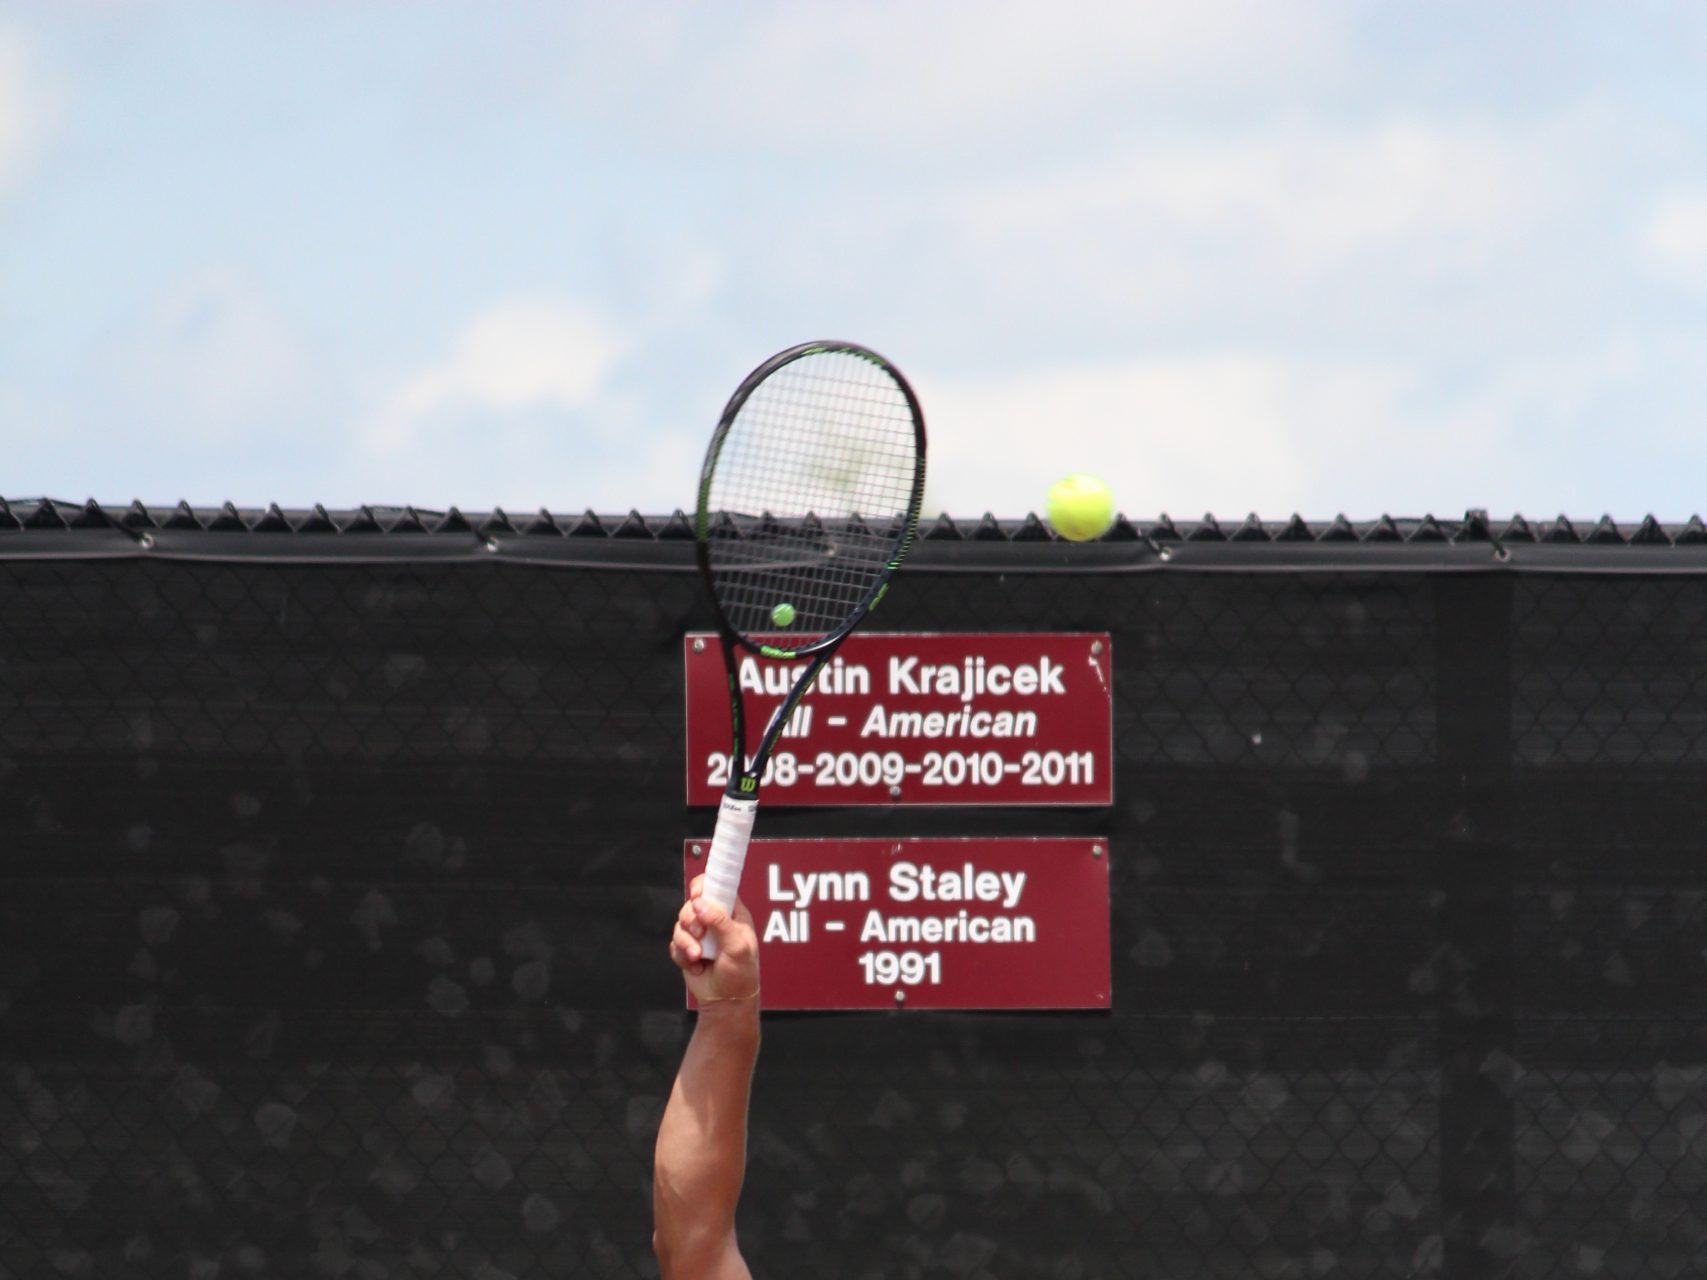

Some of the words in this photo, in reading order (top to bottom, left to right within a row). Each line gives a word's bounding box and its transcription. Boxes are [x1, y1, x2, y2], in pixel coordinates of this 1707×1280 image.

[888, 655, 1066, 703] Krajicek
[827, 716, 849, 726] -
[860, 703, 1038, 738] American
[767, 862, 870, 909] Lynn
[888, 861, 1027, 909] Staley
[762, 910, 811, 944] All
[825, 921, 847, 931] -
[859, 911, 1037, 944] American
[857, 951, 942, 986] 1991
